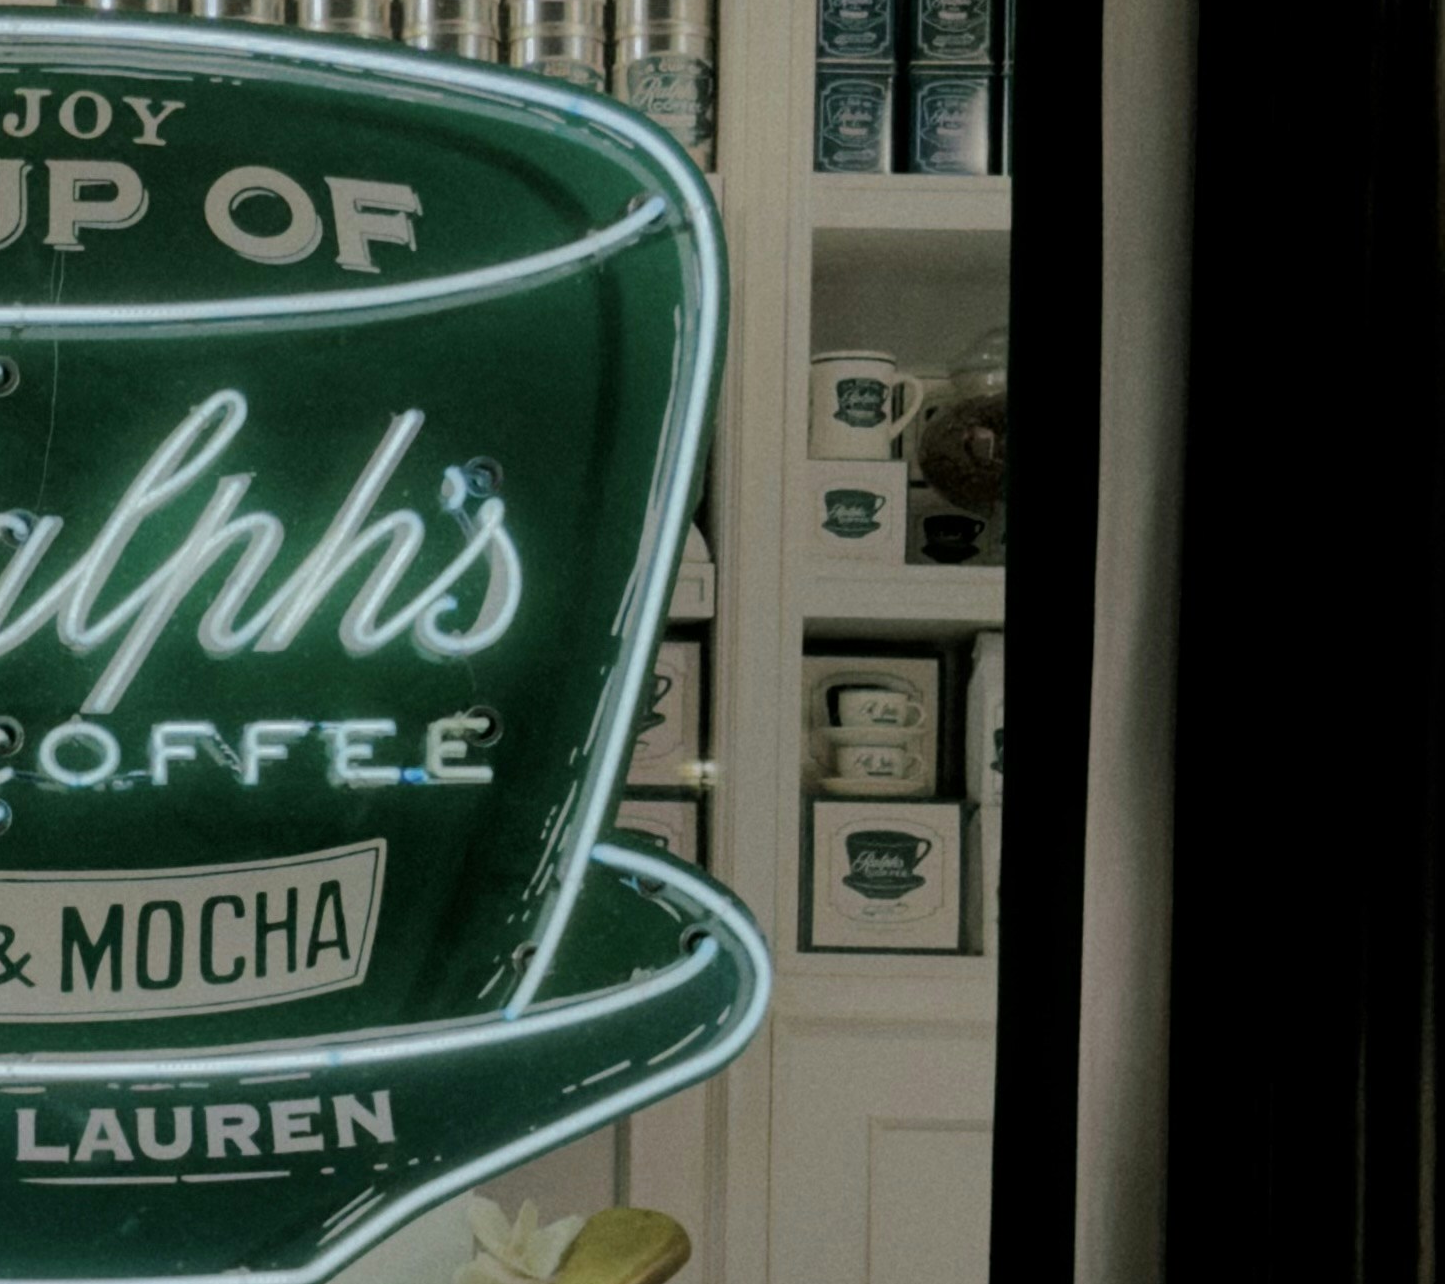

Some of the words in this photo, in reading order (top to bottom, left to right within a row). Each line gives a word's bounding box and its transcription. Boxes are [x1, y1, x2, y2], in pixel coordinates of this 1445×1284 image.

[203, 164, 426, 275] OF
[59, 879, 352, 994] MOCHA
[14, 1088, 397, 1165] LAUREN
